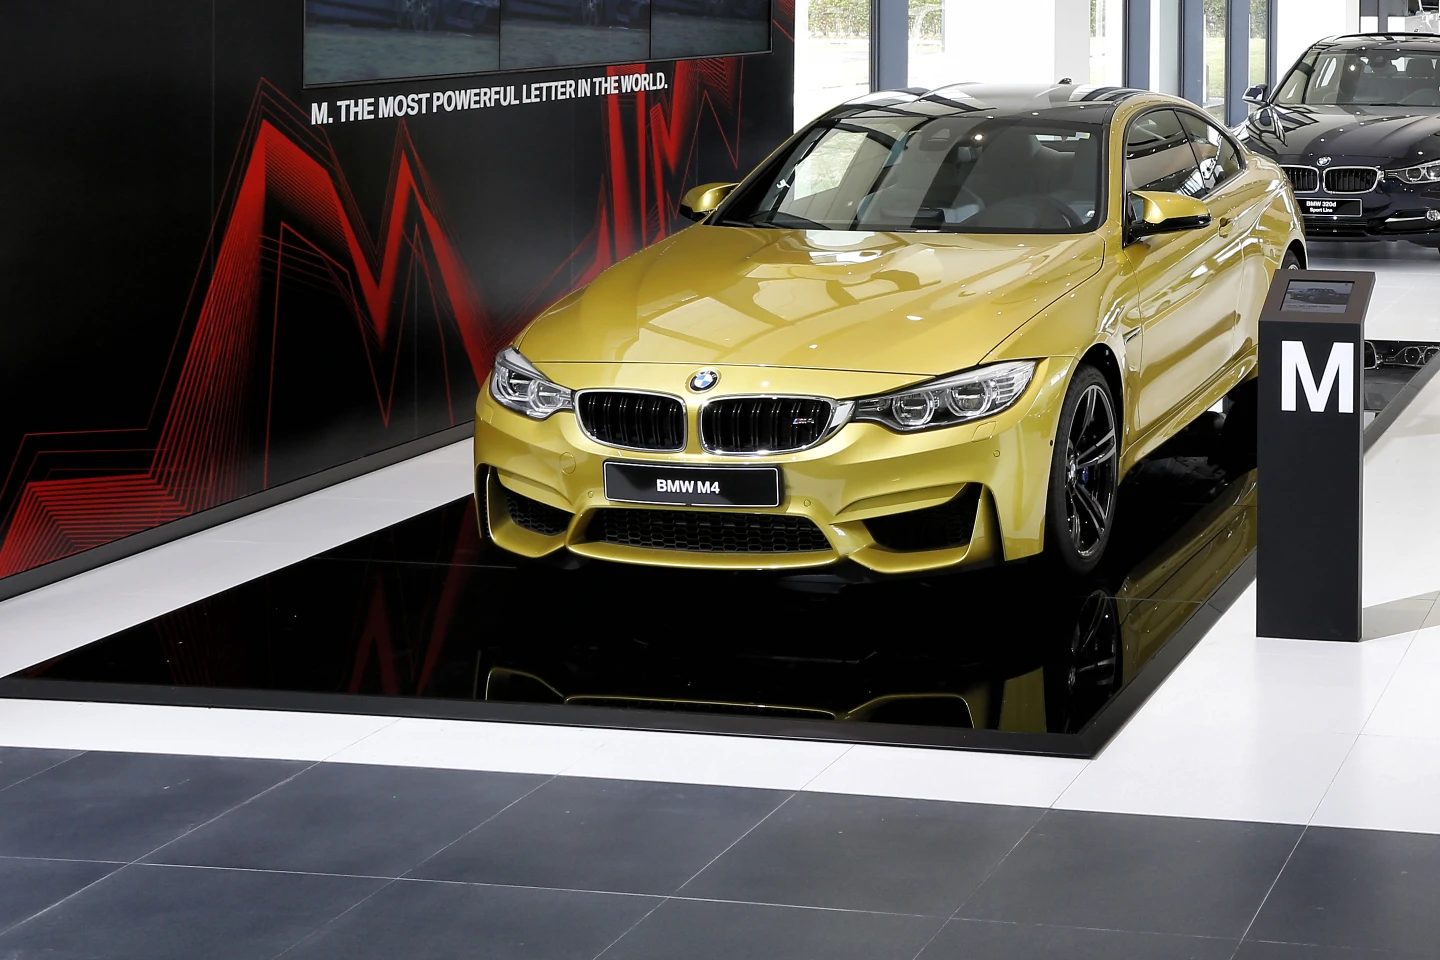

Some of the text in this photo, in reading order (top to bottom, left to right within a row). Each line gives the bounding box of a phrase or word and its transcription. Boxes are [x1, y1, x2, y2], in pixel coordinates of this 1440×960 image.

[311, 72, 668, 125] M. THE MOST POWERFUL LETTER IN THE WORLD.
[1281, 340, 1354, 414] M
[656, 478, 720, 494] BMW M4
